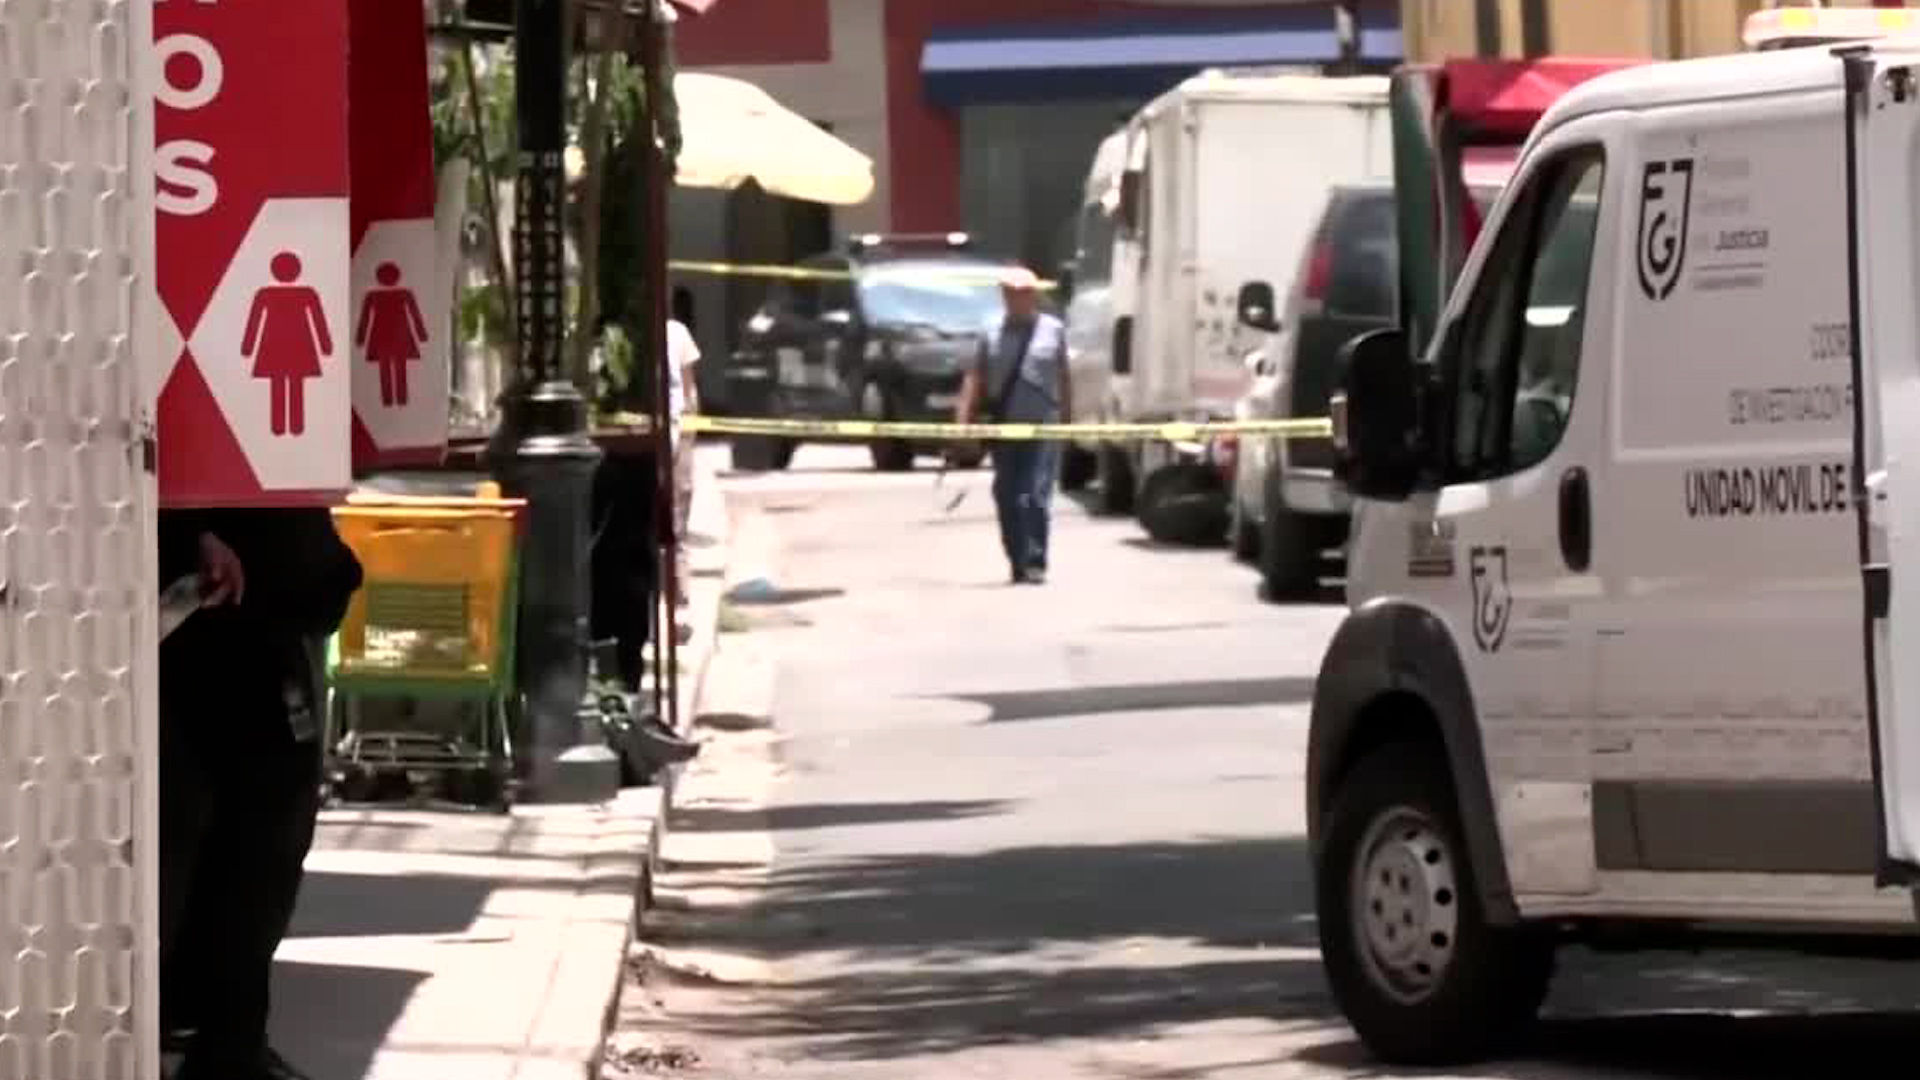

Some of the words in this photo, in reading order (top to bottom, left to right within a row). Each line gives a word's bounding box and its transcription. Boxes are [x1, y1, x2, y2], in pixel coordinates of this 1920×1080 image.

[1685, 466, 1756, 518] UNIDAD
[1759, 464, 1818, 515] MOVIL
[1819, 462, 1847, 513] DE
